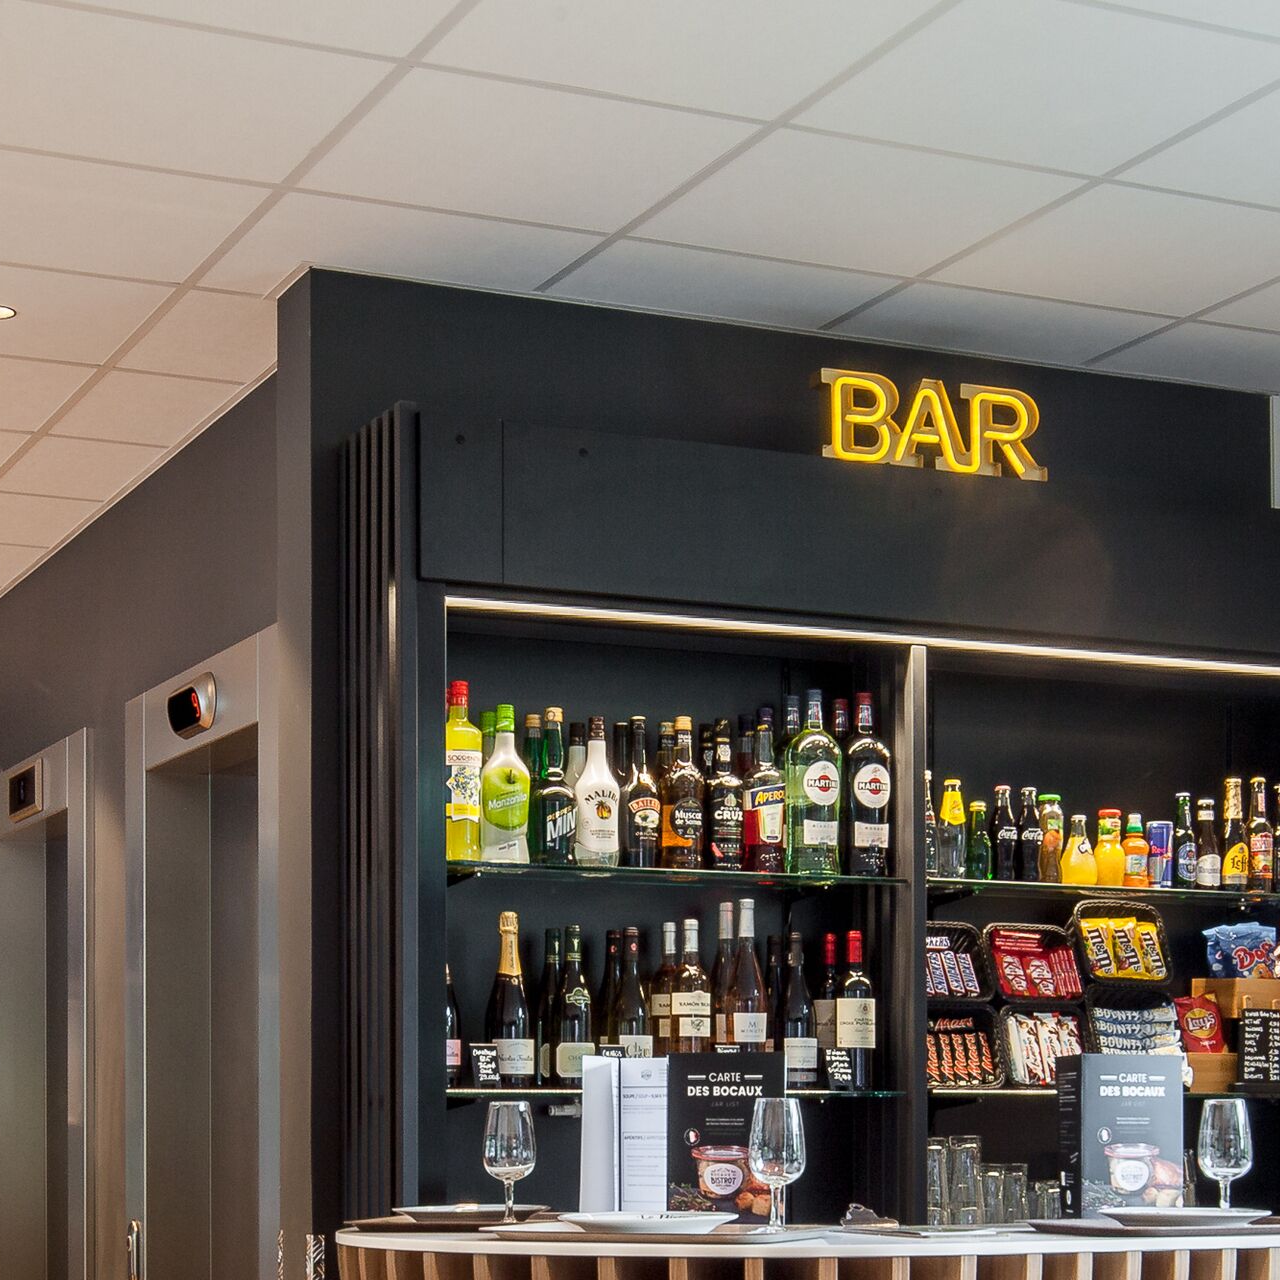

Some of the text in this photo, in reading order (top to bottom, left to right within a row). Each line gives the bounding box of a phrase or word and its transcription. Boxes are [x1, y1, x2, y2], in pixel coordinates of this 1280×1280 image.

[821, 367, 1048, 482] BAR
[1094, 1007, 1141, 1021] BOUNTY
[1100, 1036, 1143, 1050] BOUNTY
[708, 1073, 742, 1083] CARTE
[1119, 1073, 1148, 1083] CARTE
[687, 1086, 763, 1097] DES BOCAUX
[1099, 1086, 1166, 1097] DES BOCAUX
